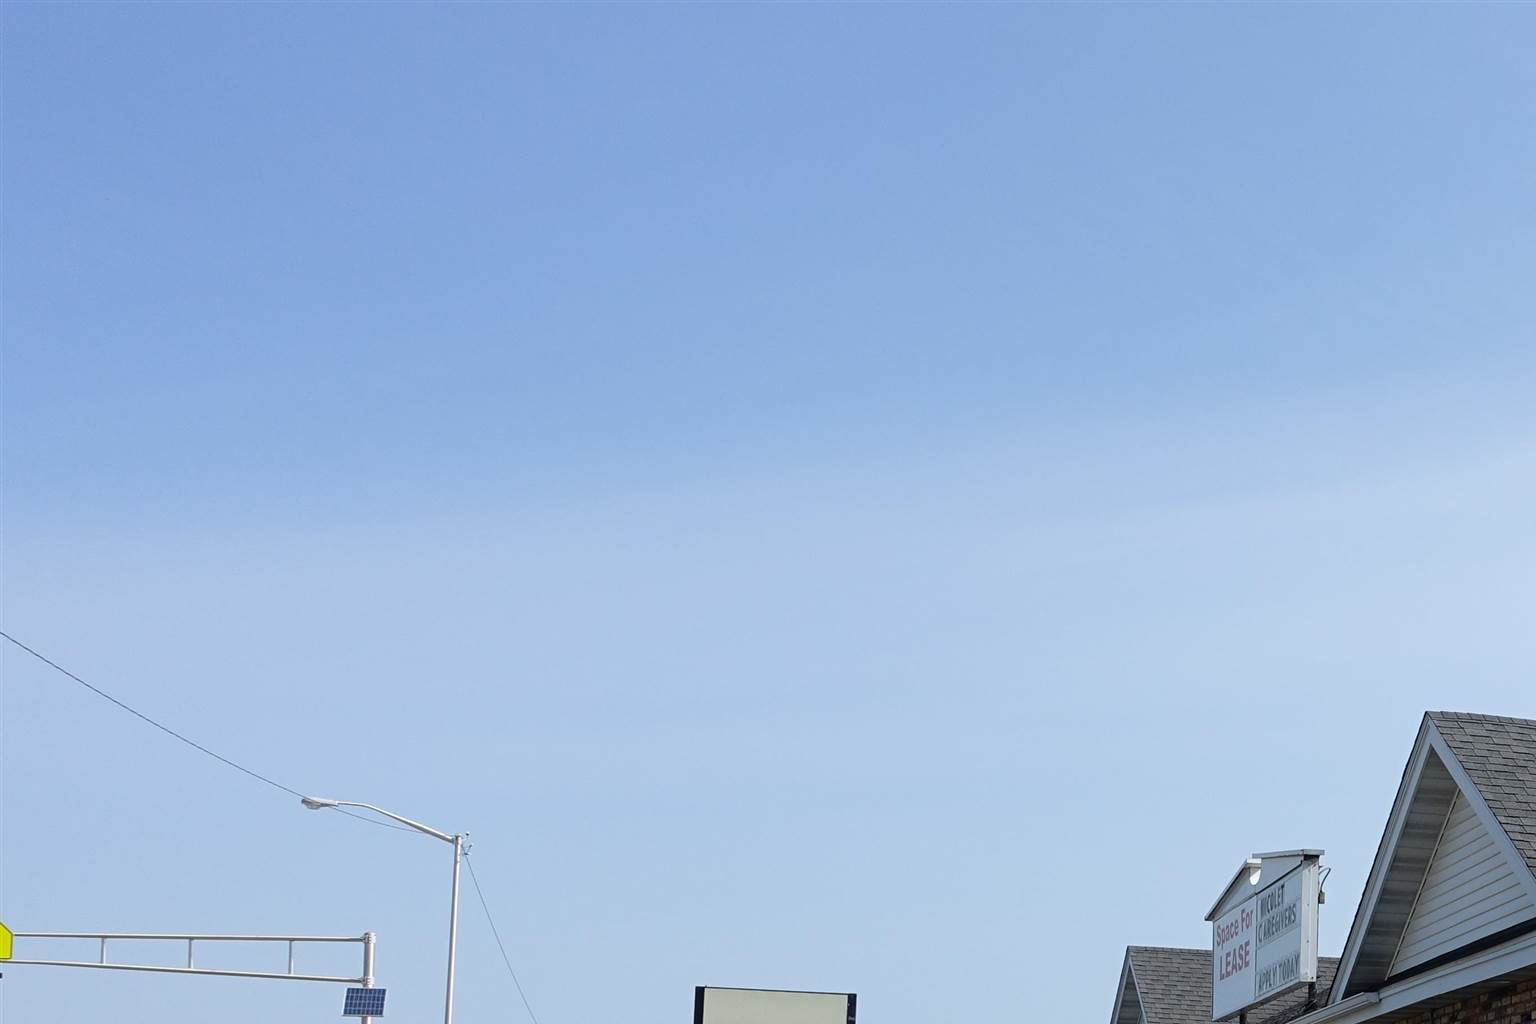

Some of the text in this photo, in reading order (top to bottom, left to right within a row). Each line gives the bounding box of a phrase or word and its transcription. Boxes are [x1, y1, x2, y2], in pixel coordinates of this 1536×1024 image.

[1216, 908, 1253, 950] Space For
[1258, 904, 1297, 943] CAREGIVERS
[1220, 940, 1250, 980] LEASE
